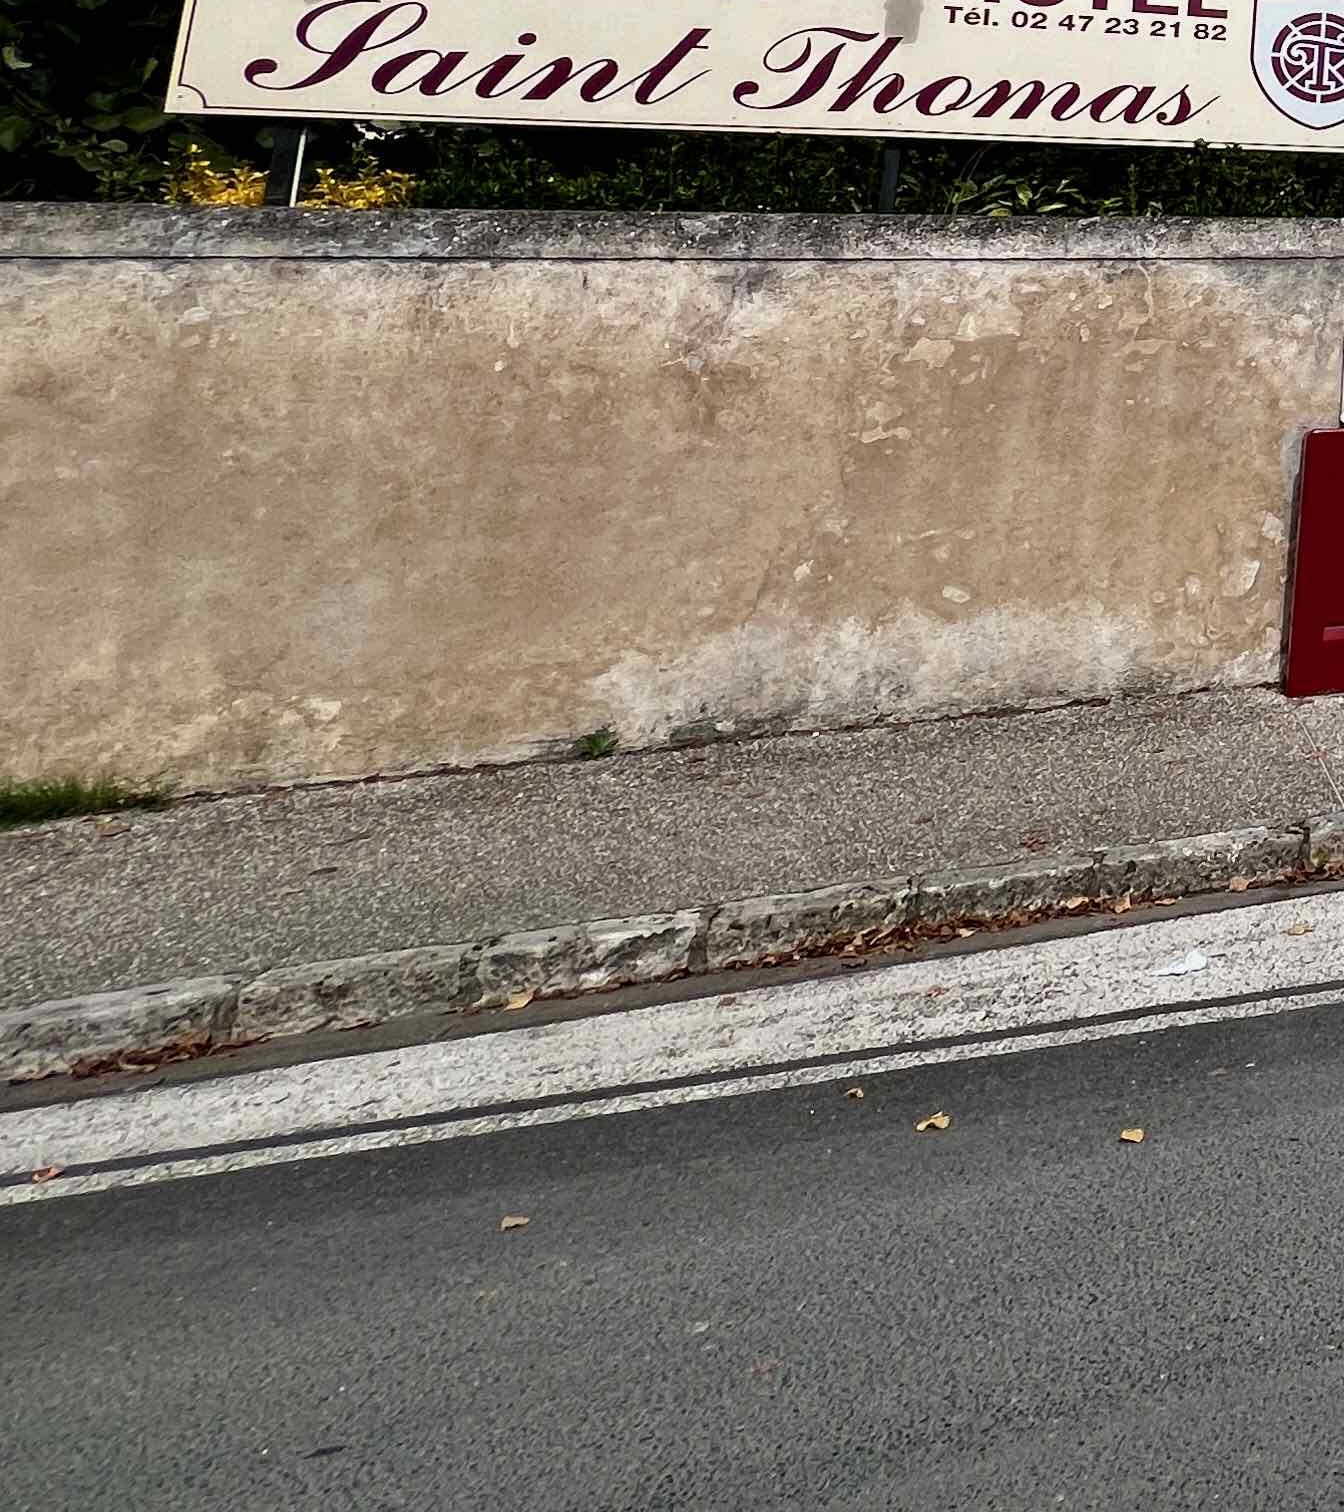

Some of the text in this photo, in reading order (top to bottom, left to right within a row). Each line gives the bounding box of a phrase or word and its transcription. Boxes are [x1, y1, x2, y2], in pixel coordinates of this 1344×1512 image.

[943, 5, 1228, 41] Tél. 02 47 23 21 82
[733, 26, 1220, 127] Thomas
